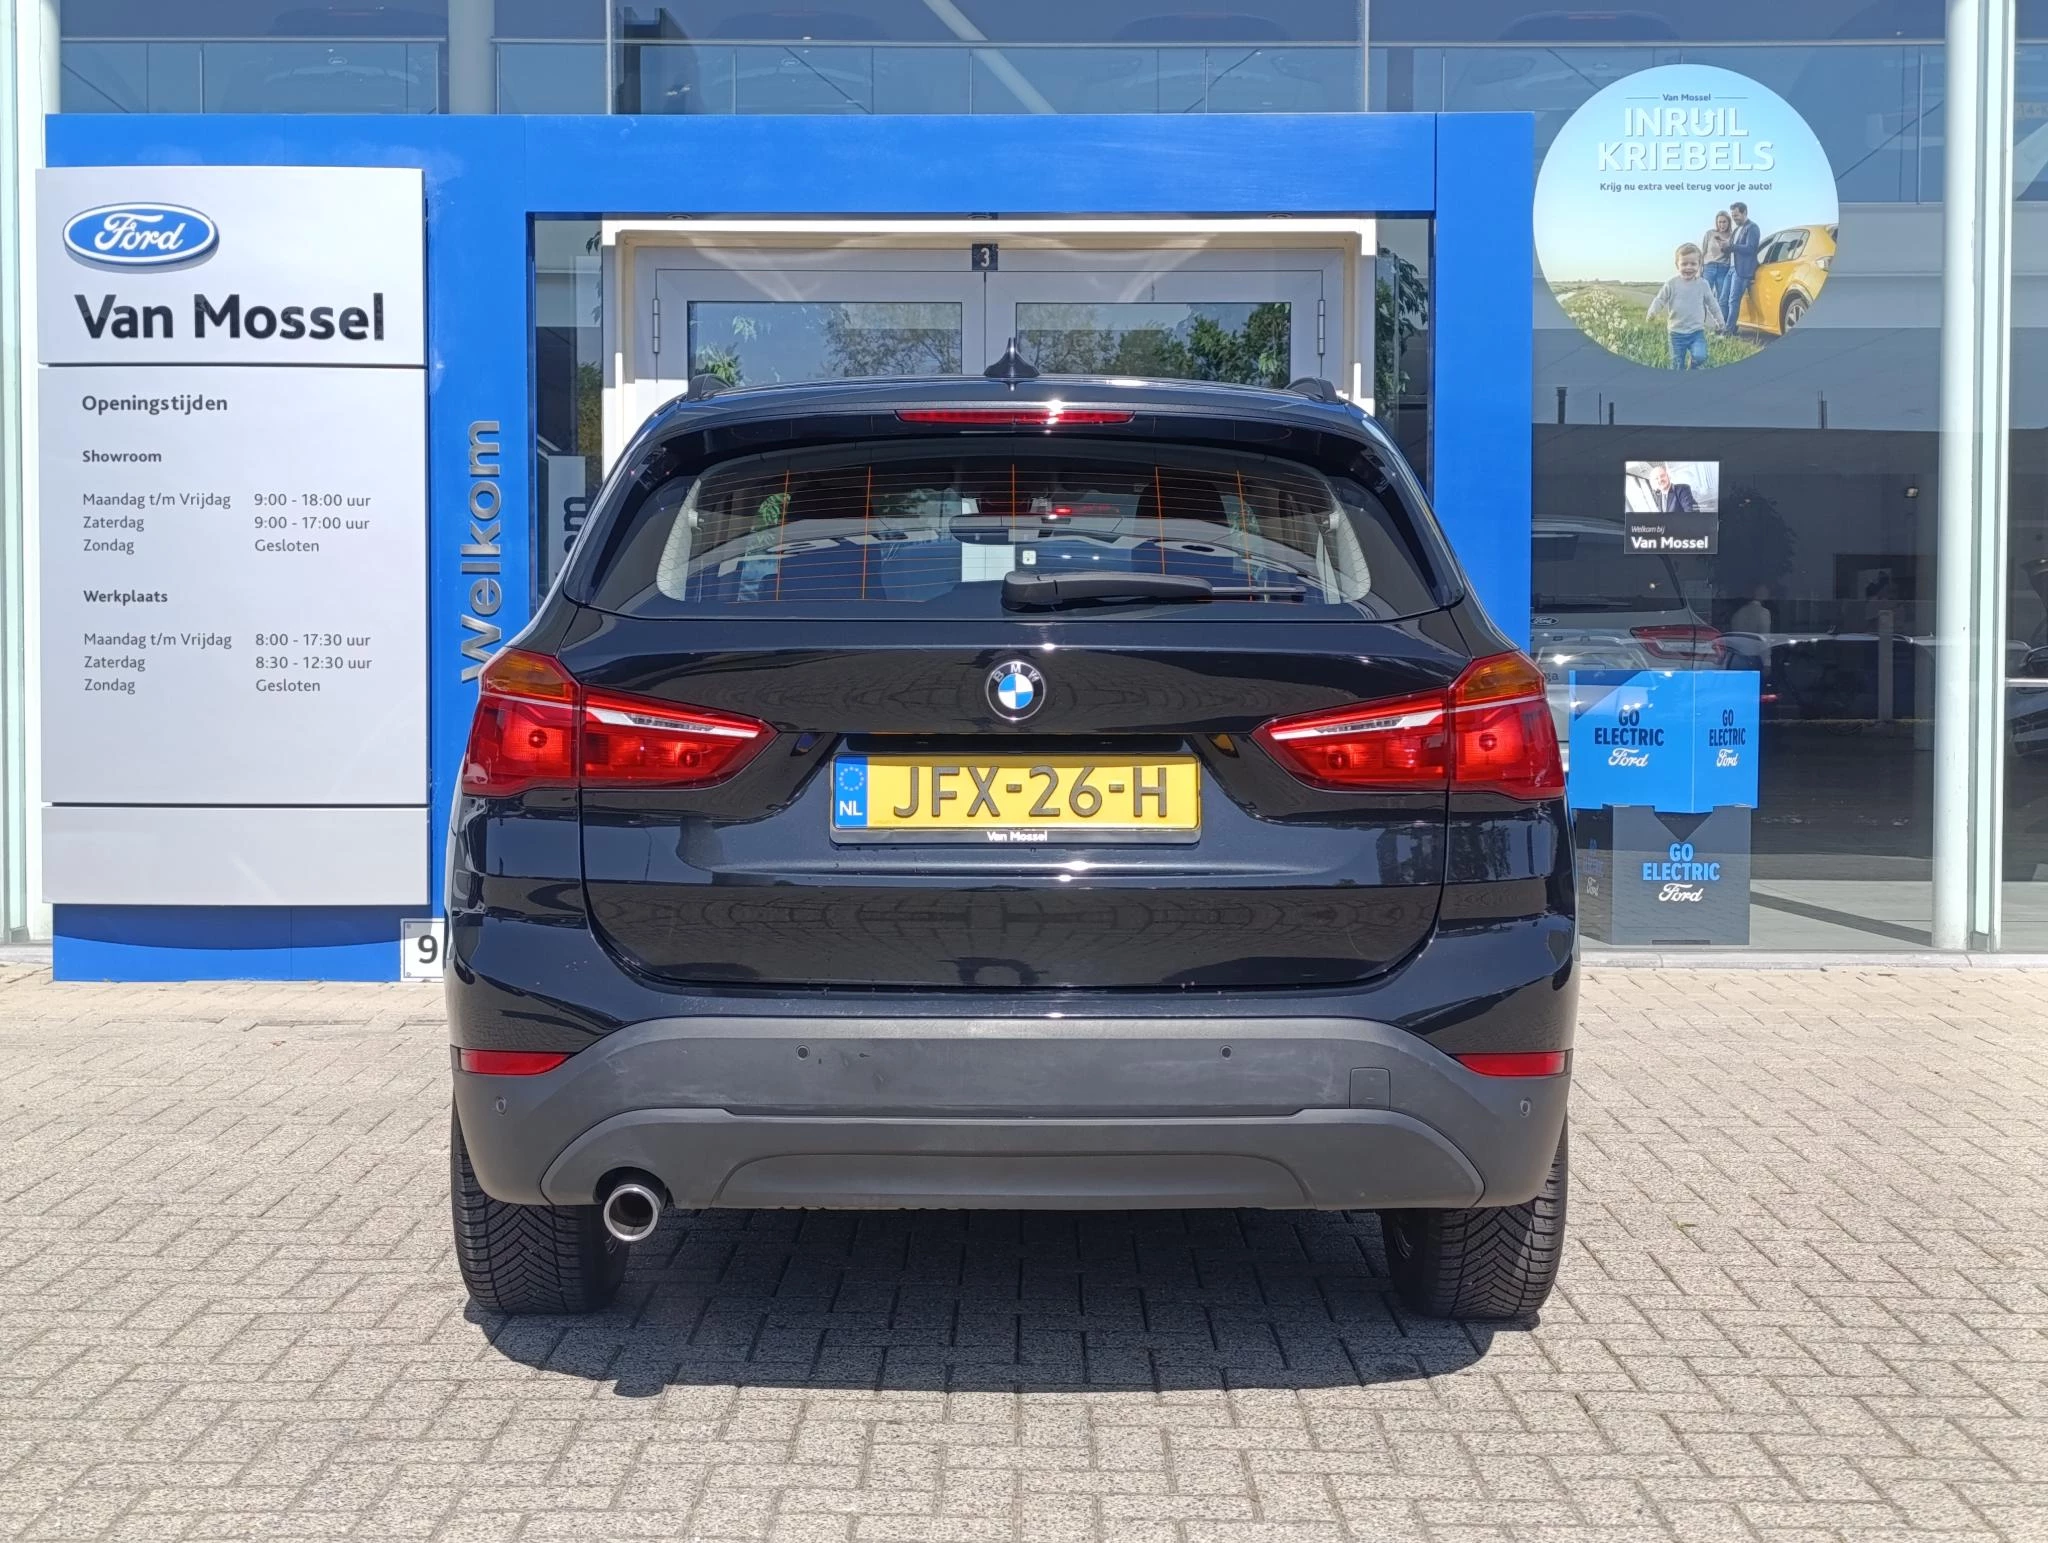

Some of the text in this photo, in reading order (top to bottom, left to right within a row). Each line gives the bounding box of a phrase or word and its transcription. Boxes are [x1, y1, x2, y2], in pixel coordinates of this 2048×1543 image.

[1662, 93, 1711, 101] Van Mossel
[1624, 107, 1749, 137] INRUIL
[1598, 141, 1775, 171] KRIEBELS
[1600, 183, 1622, 192] Krijg
[1637, 183, 1662, 191] extra
[1665, 182, 1684, 191] veel
[1687, 183, 1712, 193] terug
[1737, 183, 1746, 193] je
[1748, 183, 1773, 191] auto!
[94, 214, 183, 251] Ford
[980, 247, 990, 267] 3
[75, 293, 384, 340] Van Mossel
[82, 395, 227, 415] Openingstijden
[82, 449, 162, 463] Showroom
[82, 492, 146, 510] Maandag
[148, 492, 176, 506] t/m
[179, 492, 231, 510] Vrijdag
[254, 493, 287, 506] 9:00
[301, 493, 343, 507] 18:00
[346, 497, 372, 507] uur
[83, 515, 145, 533] Zaterdag
[254, 515, 288, 529] 9:00
[301, 516, 342, 530] 17:00
[345, 519, 371, 530] uur
[83, 538, 320, 556] Zondag Gesloten
[1631, 535, 1709, 549] Van Mossel
[461, 420, 502, 683] Welkom
[82, 589, 168, 607] Werkplaats
[84, 632, 147, 650] Maandag
[150, 632, 177, 646] t/m
[180, 632, 233, 650] Vrijdag
[255, 633, 289, 646] 8:00
[303, 633, 343, 647] 17:30
[346, 636, 371, 647] uur
[83, 655, 146, 673] Zaterdag
[255, 656, 289, 669] 8:30
[303, 656, 344, 670] 12:30
[348, 659, 373, 670] uur
[83, 677, 321, 696] Zondag Gesloten
[1618, 708, 1640, 726] GO
[1722, 708, 1734, 727] GO
[1595, 728, 1664, 746] ELECTRIC
[1709, 728, 1746, 746] ELECTRIC
[1608, 748, 1649, 767] Ford
[1716, 749, 1738, 767] Ford
[893, 765, 1167, 818] JFX-26-H
[840, 801, 863, 816] NL
[986, 830, 1048, 842] Van Mossel
[1669, 843, 1694, 862] GO
[1642, 862, 1720, 881] ELECTRIC
[1658, 882, 1704, 902] Ford
[417, 934, 439, 965] 9
